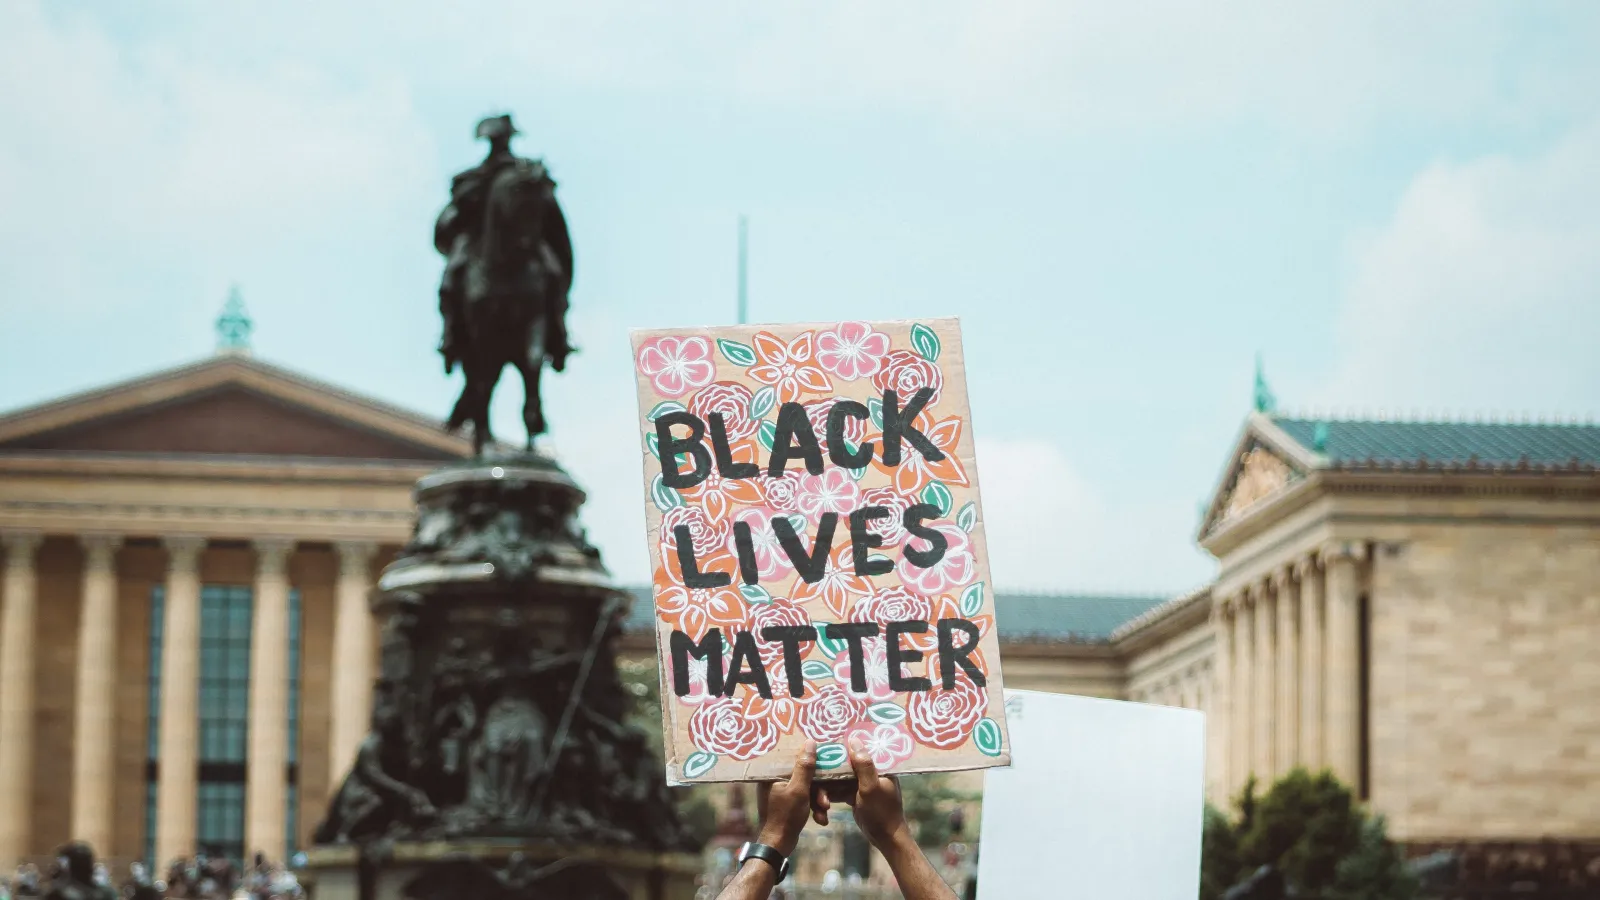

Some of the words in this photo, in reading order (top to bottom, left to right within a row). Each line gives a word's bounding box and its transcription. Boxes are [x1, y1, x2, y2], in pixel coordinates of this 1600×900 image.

[655, 387, 945, 488] BLACK
[674, 503, 948, 588] LIVES
[669, 618, 986, 699] MATTER
